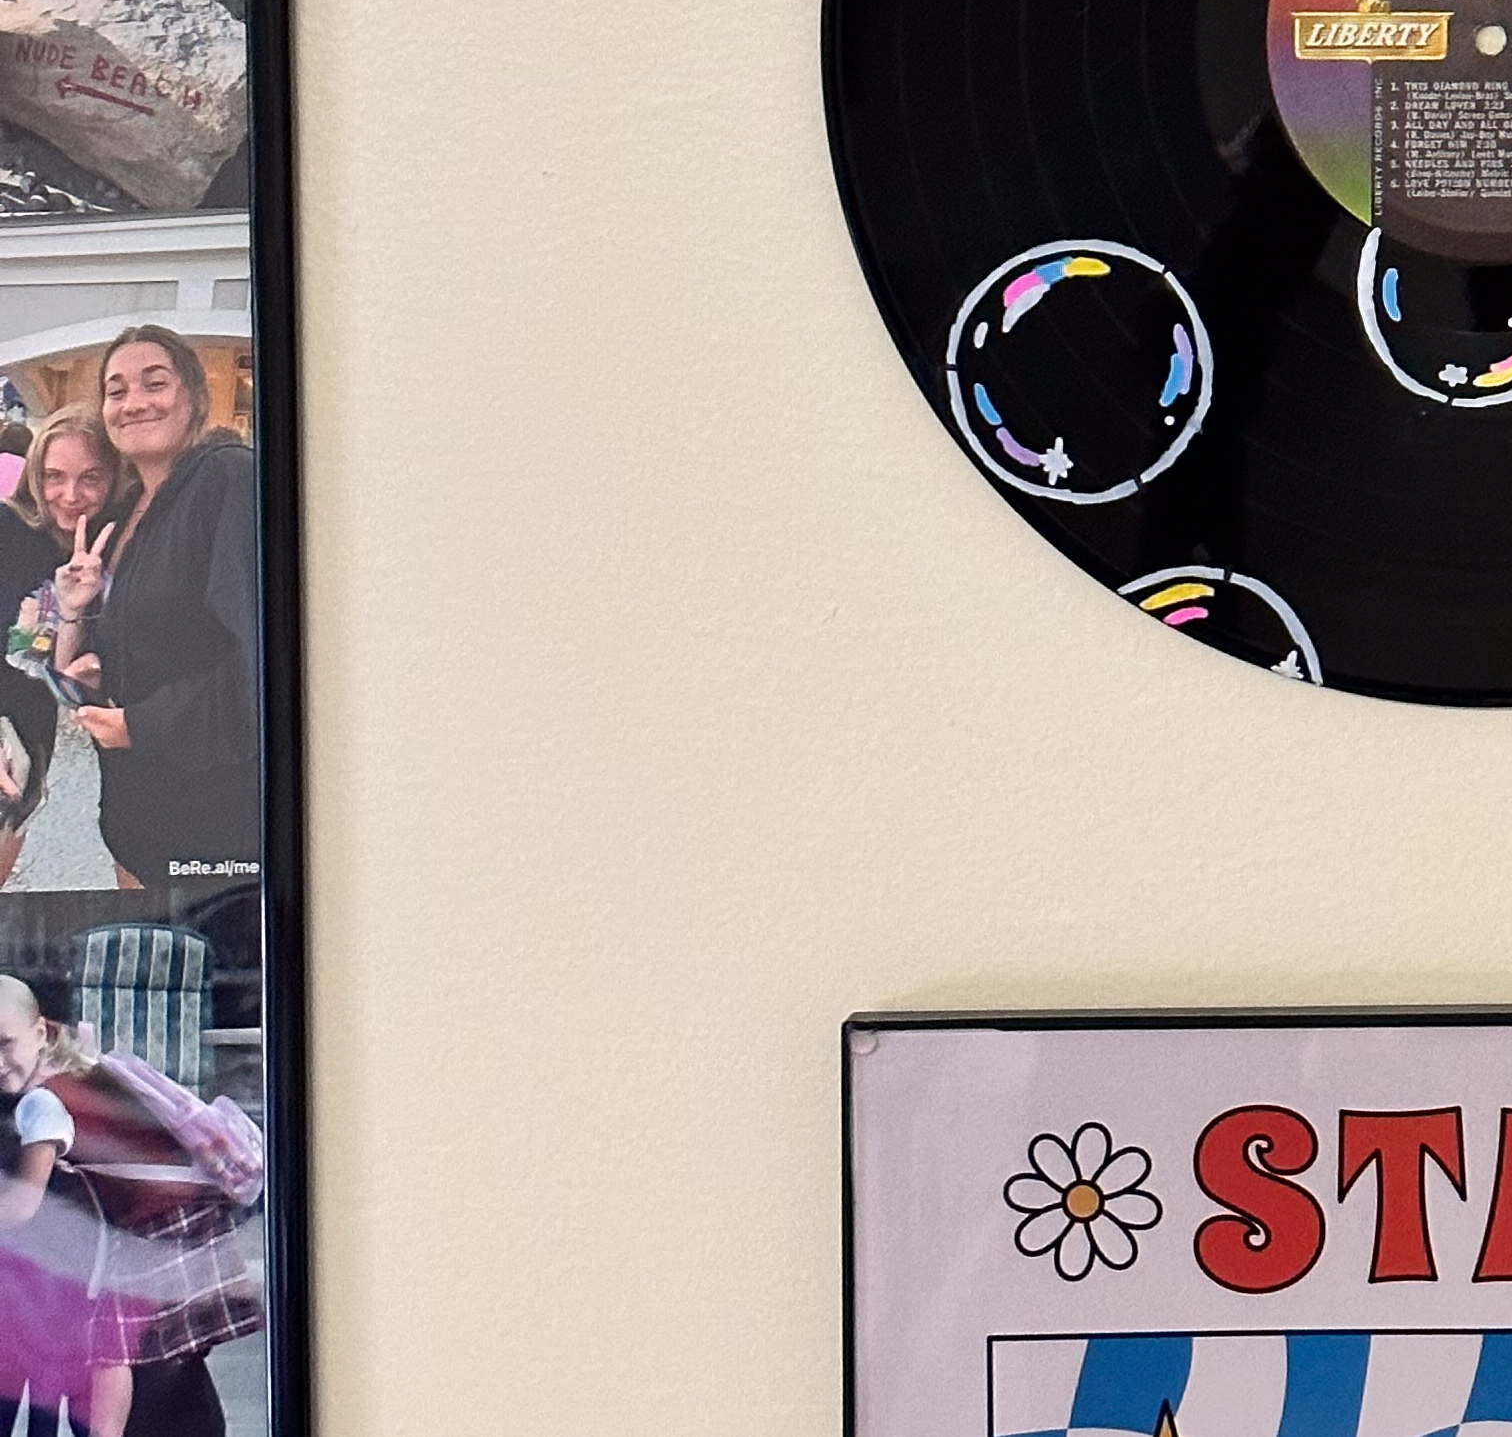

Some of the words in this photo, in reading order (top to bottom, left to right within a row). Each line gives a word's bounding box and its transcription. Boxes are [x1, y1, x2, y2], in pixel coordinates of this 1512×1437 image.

[1306, 23, 1440, 47] LIBERTY
[15, 37, 77, 69] NUDE
[91, 54, 203, 111] BEACH
[1375, 106, 1383, 162] RECORDS
[1375, 166, 1383, 216] LIBERTY
